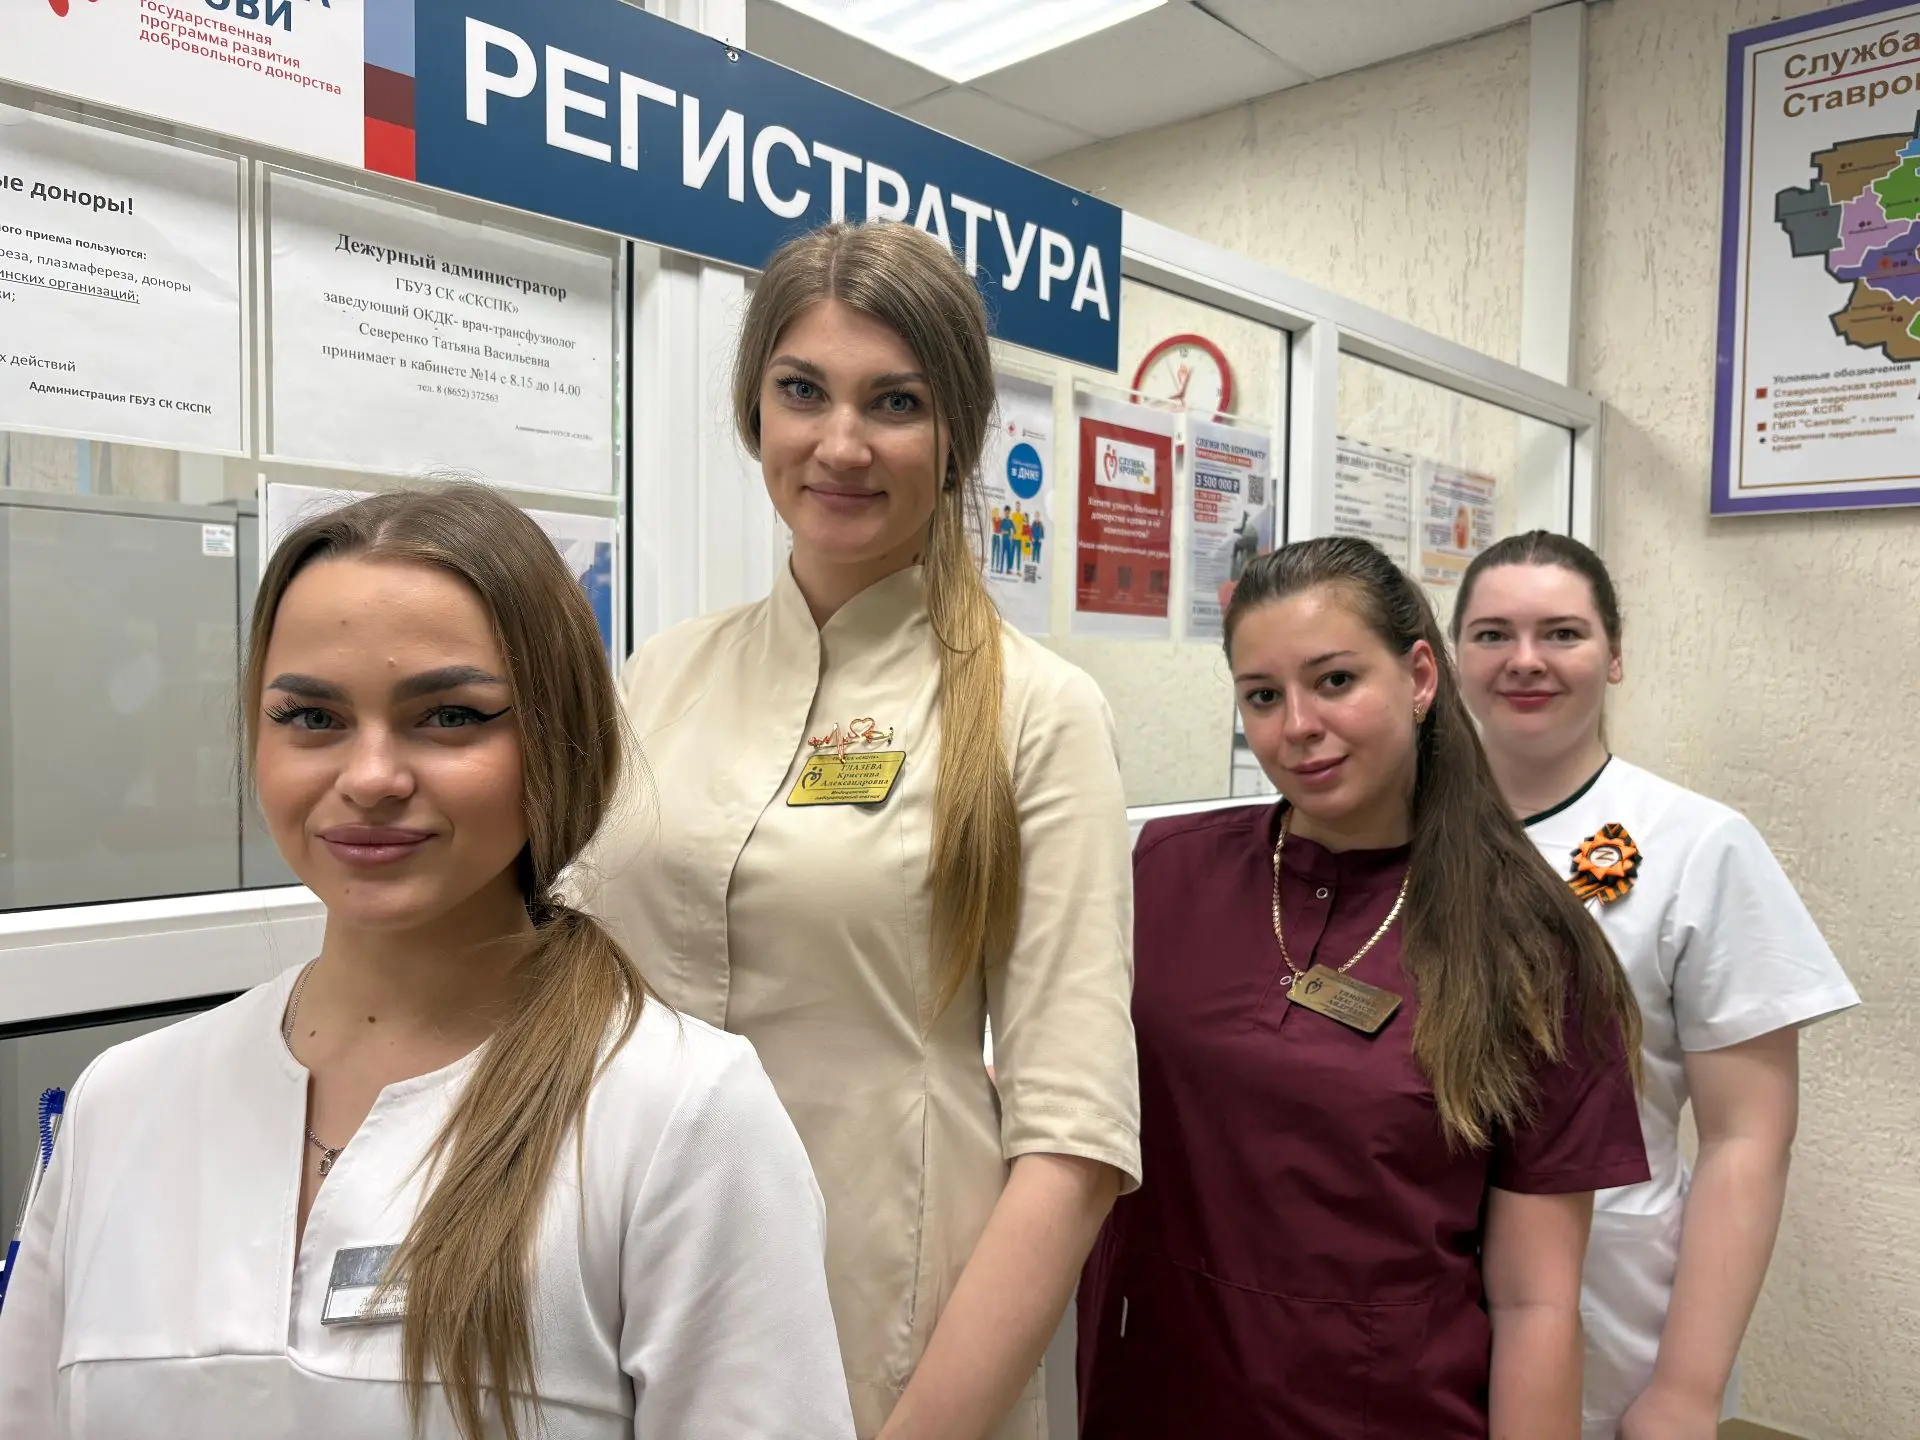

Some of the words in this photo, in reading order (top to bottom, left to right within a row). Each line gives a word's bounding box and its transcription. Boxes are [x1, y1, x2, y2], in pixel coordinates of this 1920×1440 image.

[140, 0, 272, 46] государственная
[140, 14, 228, 47] программа
[232, 41, 300, 68] развития
[140, 29, 262, 72] добровольного
[265, 65, 341, 95] донорства
[1784, 30, 1920, 79] Служба
[465, 16, 1111, 322] РЕГИСТРАТУРА
[30, 182, 133, 215] доноры!
[0, 224, 22, 236] ого
[25, 229, 72, 245] приема
[75, 239, 147, 260] пользуются:
[37, 255, 138, 283] плазмафереза,
[141, 275, 191, 293] доноры
[49, 278, 140, 303] организаций;
[335, 233, 436, 270] Дежурный
[441, 261, 567, 302] администратор
[396, 277, 432, 296] ГБУЗ
[435, 286, 455, 301] СК
[458, 292, 519, 314] «СКСПК»
[323, 291, 409, 317] заведующий
[462, 319, 577, 350] врач-трансфузиолог
[10, 355, 76, 373] действий
[359, 322, 429, 346] Северенко
[431, 335, 481, 356] Татьяна
[484, 345, 550, 368] Васильевна
[322, 345, 396, 366] принимает
[400, 358, 407, 368] в
[411, 360, 467, 377] кабинете
[470, 367, 497, 383] №14
[500, 375, 507, 385] с
[536, 381, 550, 393] до
[29, 381, 126, 403] Администрация
[129, 394, 156, 407] ГБУЗ
[159, 398, 173, 409] СК
[175, 401, 212, 415] СКСПК
